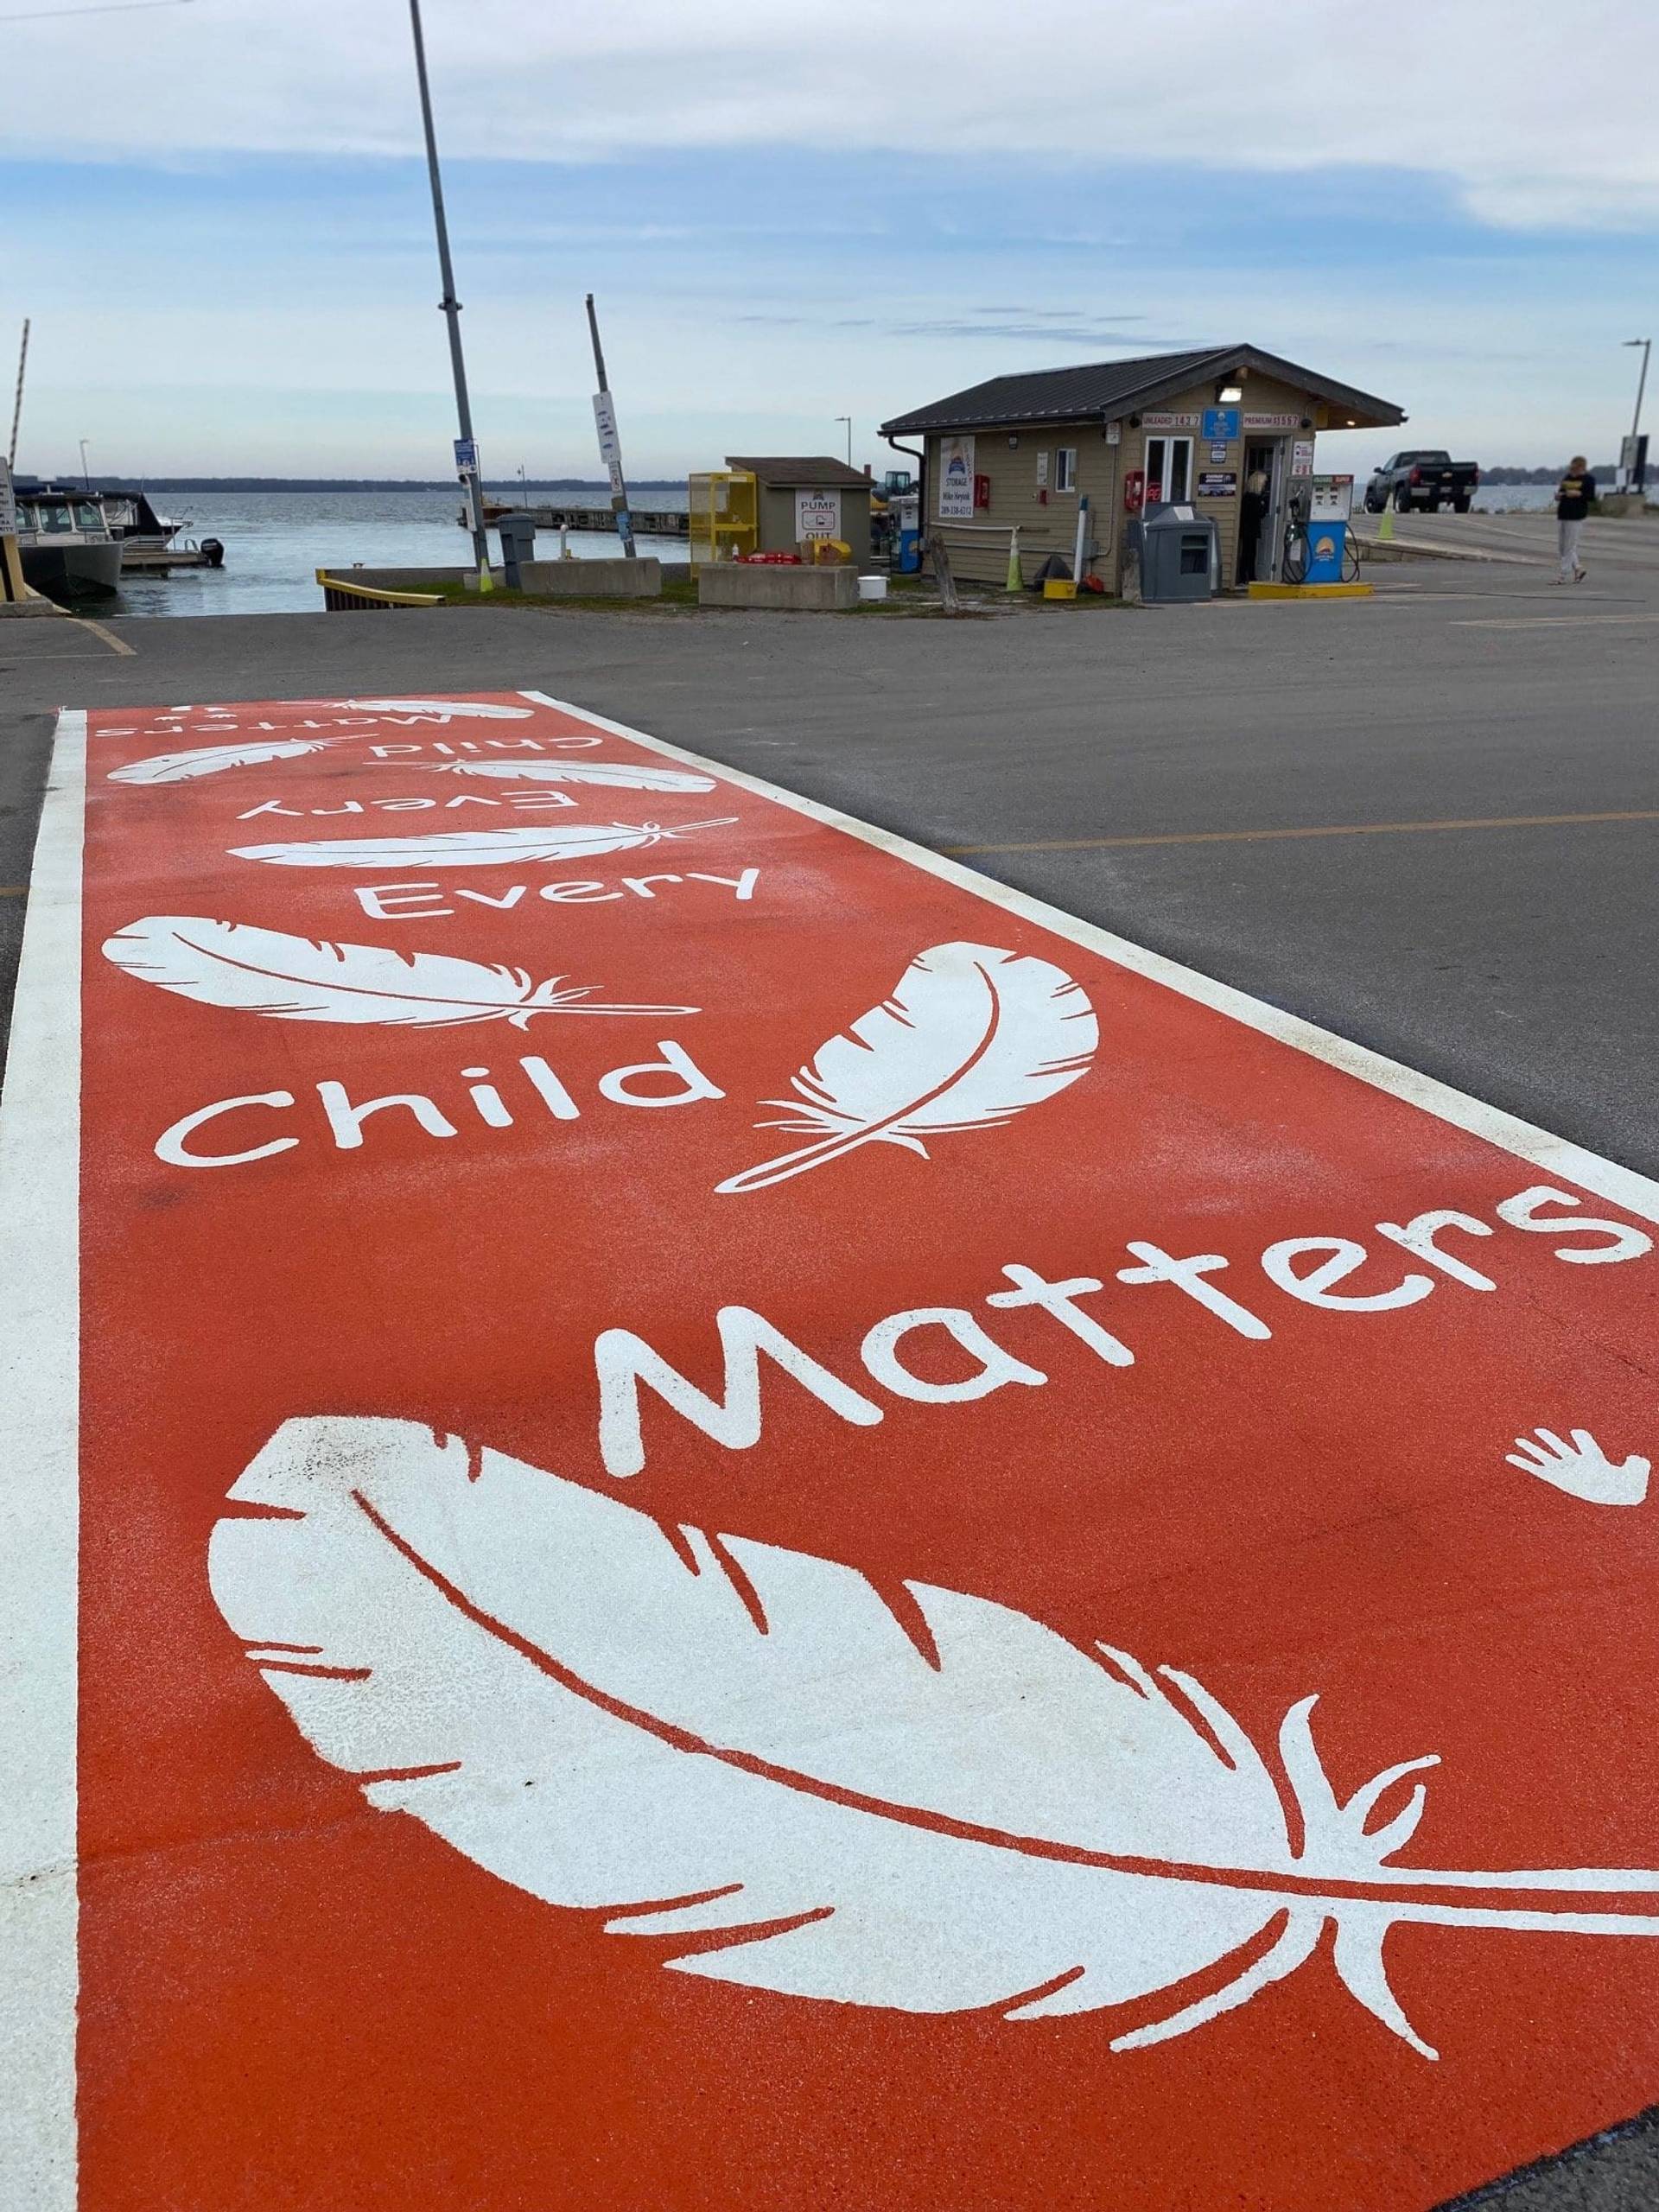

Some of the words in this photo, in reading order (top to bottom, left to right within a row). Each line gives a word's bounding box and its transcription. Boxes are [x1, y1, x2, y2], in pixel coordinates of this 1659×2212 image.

[946, 477, 968, 486] STORAGE
[94, 714, 451, 737] Matters
[368, 737, 604, 758] Child
[235, 788, 581, 821] Every
[353, 866, 763, 920] Every
[154, 1040, 727, 1168] Child
[594, 1185, 1656, 1479] Matters
